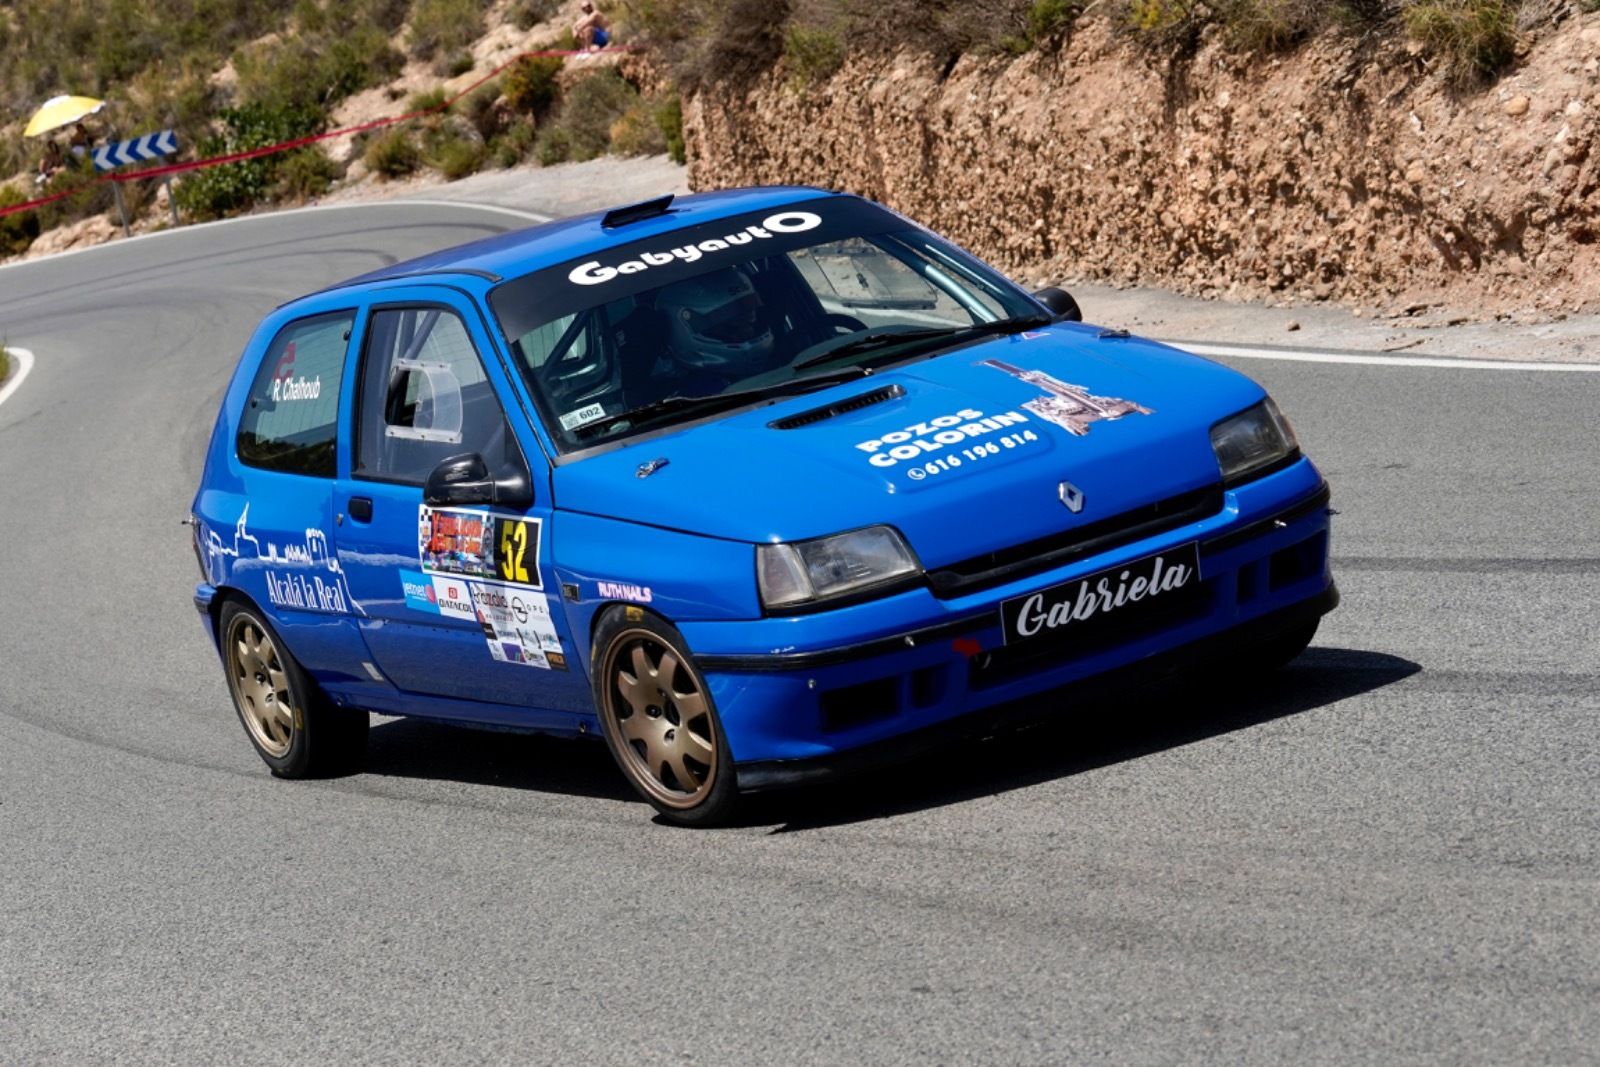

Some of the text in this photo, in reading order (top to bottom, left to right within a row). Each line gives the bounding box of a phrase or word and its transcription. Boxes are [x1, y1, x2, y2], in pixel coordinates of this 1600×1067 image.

[579, 406, 600, 419] 602
[855, 408, 983, 453] POZOS
[868, 411, 1029, 467] COLORIN
[925, 430, 1038, 475] 616 196 814
[500, 520, 530, 583] 52
[265, 570, 348, 612] Alcalá la Real
[1016, 556, 1192, 637] Gabriela
